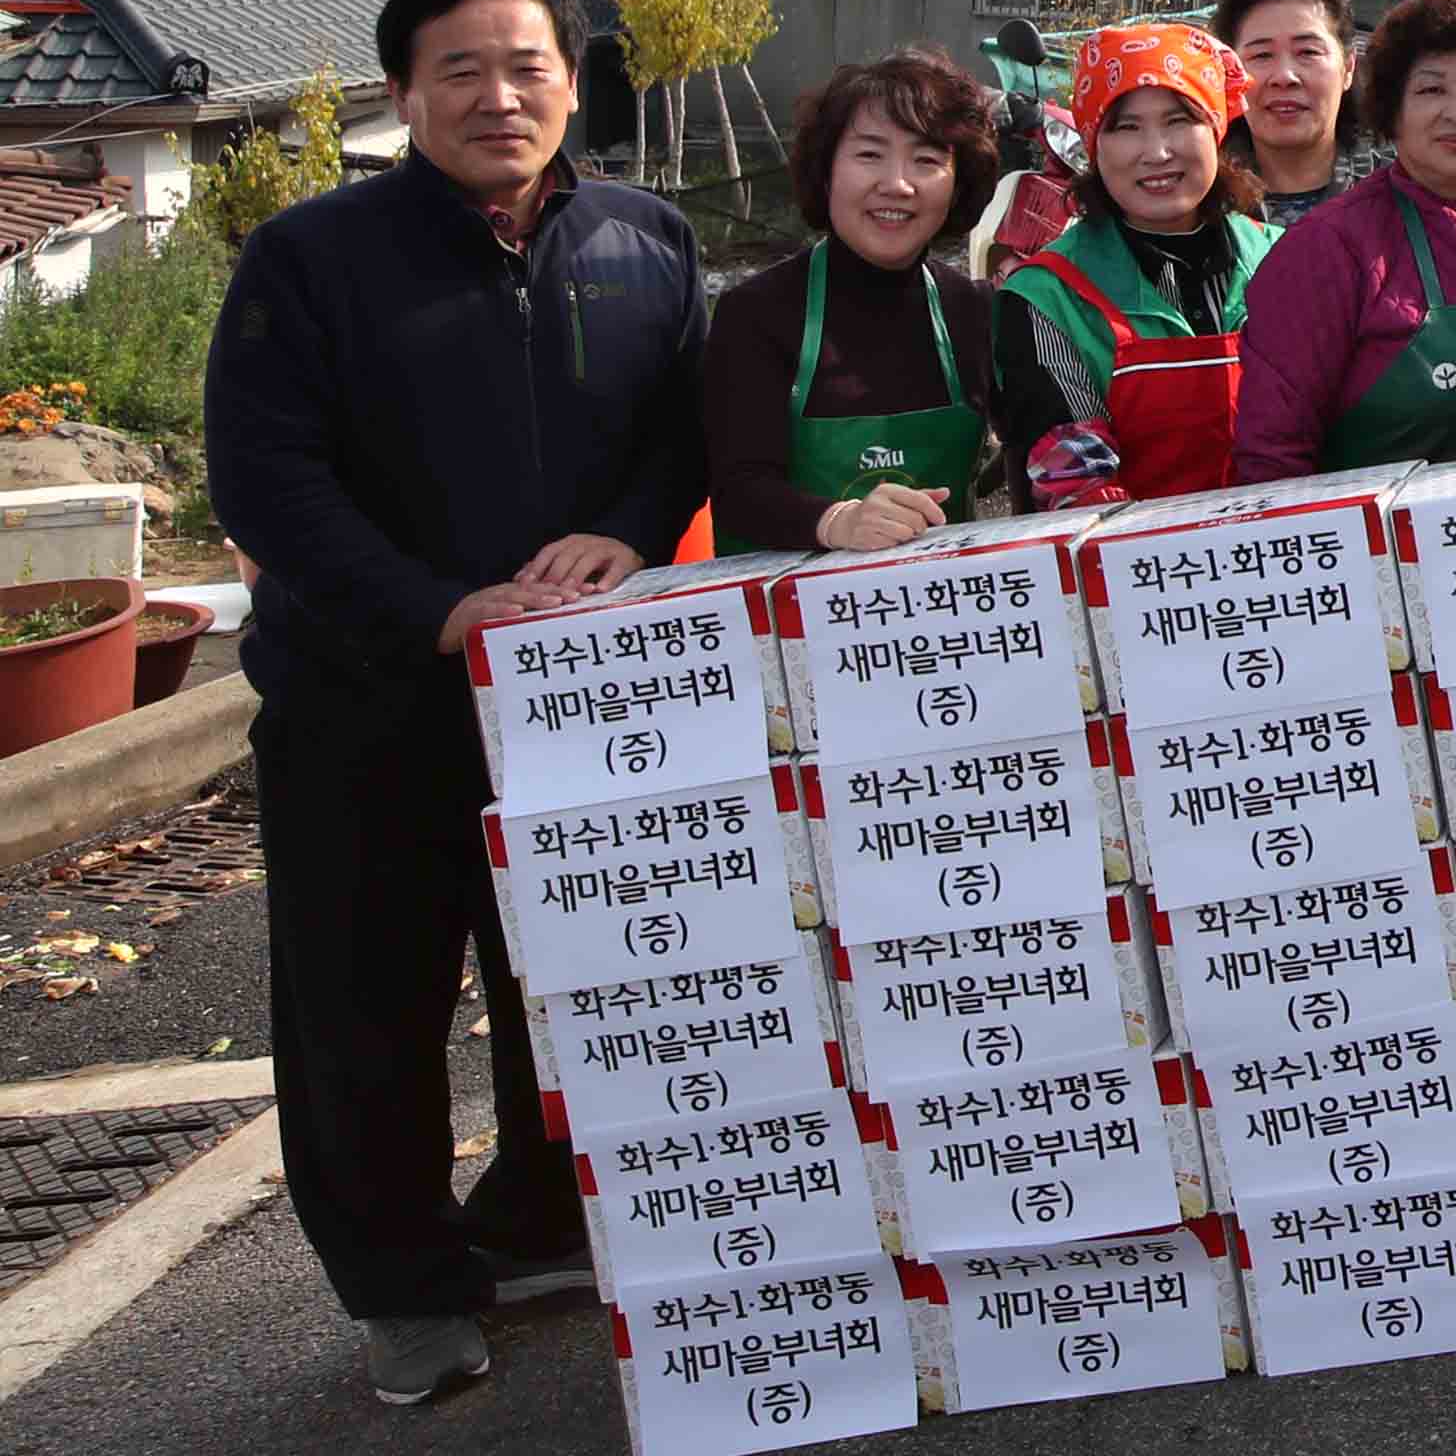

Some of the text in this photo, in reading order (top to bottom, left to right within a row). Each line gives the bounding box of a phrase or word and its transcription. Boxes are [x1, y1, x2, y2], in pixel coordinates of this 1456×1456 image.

[1140, 581, 1352, 647] 새마을부녀회
[835, 619, 1045, 684] 새마을부녀회
[1221, 644, 1285, 692] (증)
[524, 662, 736, 733] 새마을부녀회
[915, 682, 979, 729] (증)
[604, 728, 668, 777] (증)
[1168, 757, 1381, 828] 새마을부녀회
[856, 798, 1072, 863] 새마을부녀회
[540, 845, 759, 915] 새마을부녀회
[1204, 924, 1418, 992] 새마을부녀회
[881, 961, 1091, 1023] 새마을부녀회
[582, 1005, 794, 1074] 새마을부녀회
[1244, 1073, 1455, 1148] 새마을부녀회
[927, 1116, 1141, 1184] 새마을부녀회
[628, 1157, 842, 1230] 새마을부녀회
[975, 1270, 1189, 1332] 새마을부녀회
[1360, 1294, 1425, 1340] (증)
[661, 1314, 883, 1386] 새마을부녀회
[1056, 1330, 1122, 1375] (증)
[745, 1378, 813, 1428] (증)
